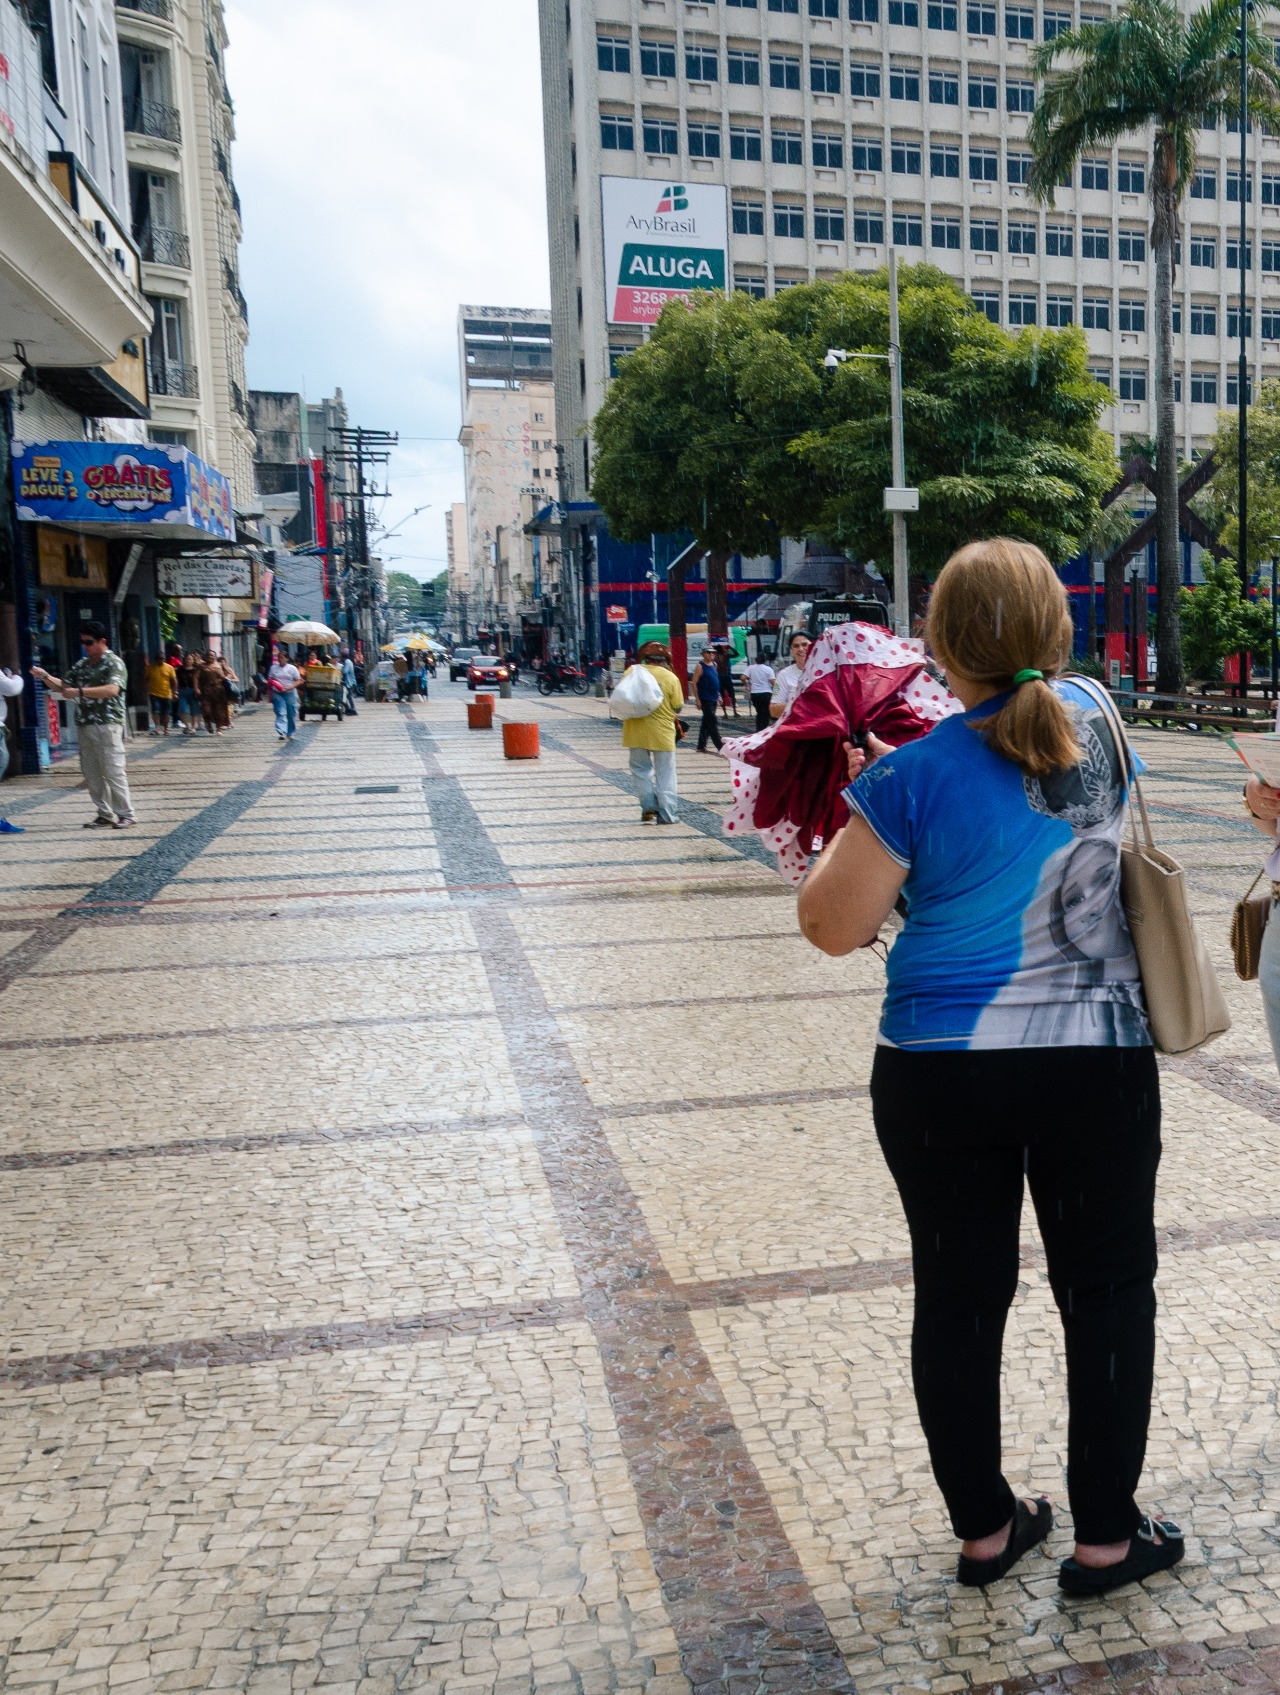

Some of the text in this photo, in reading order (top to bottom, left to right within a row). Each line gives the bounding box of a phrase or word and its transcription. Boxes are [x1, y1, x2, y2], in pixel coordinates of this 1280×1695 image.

[626, 215, 696, 235] AryBrasil
[628, 255, 714, 280] ALUGA
[21, 468, 75, 484] LEVE 3
[82, 460, 172, 490] GRÁTIS
[20, 484, 79, 500] PAGUE 2
[86, 491, 96, 500] O
[163, 562, 181, 571] Rei
[204, 560, 245, 573] Canetas
